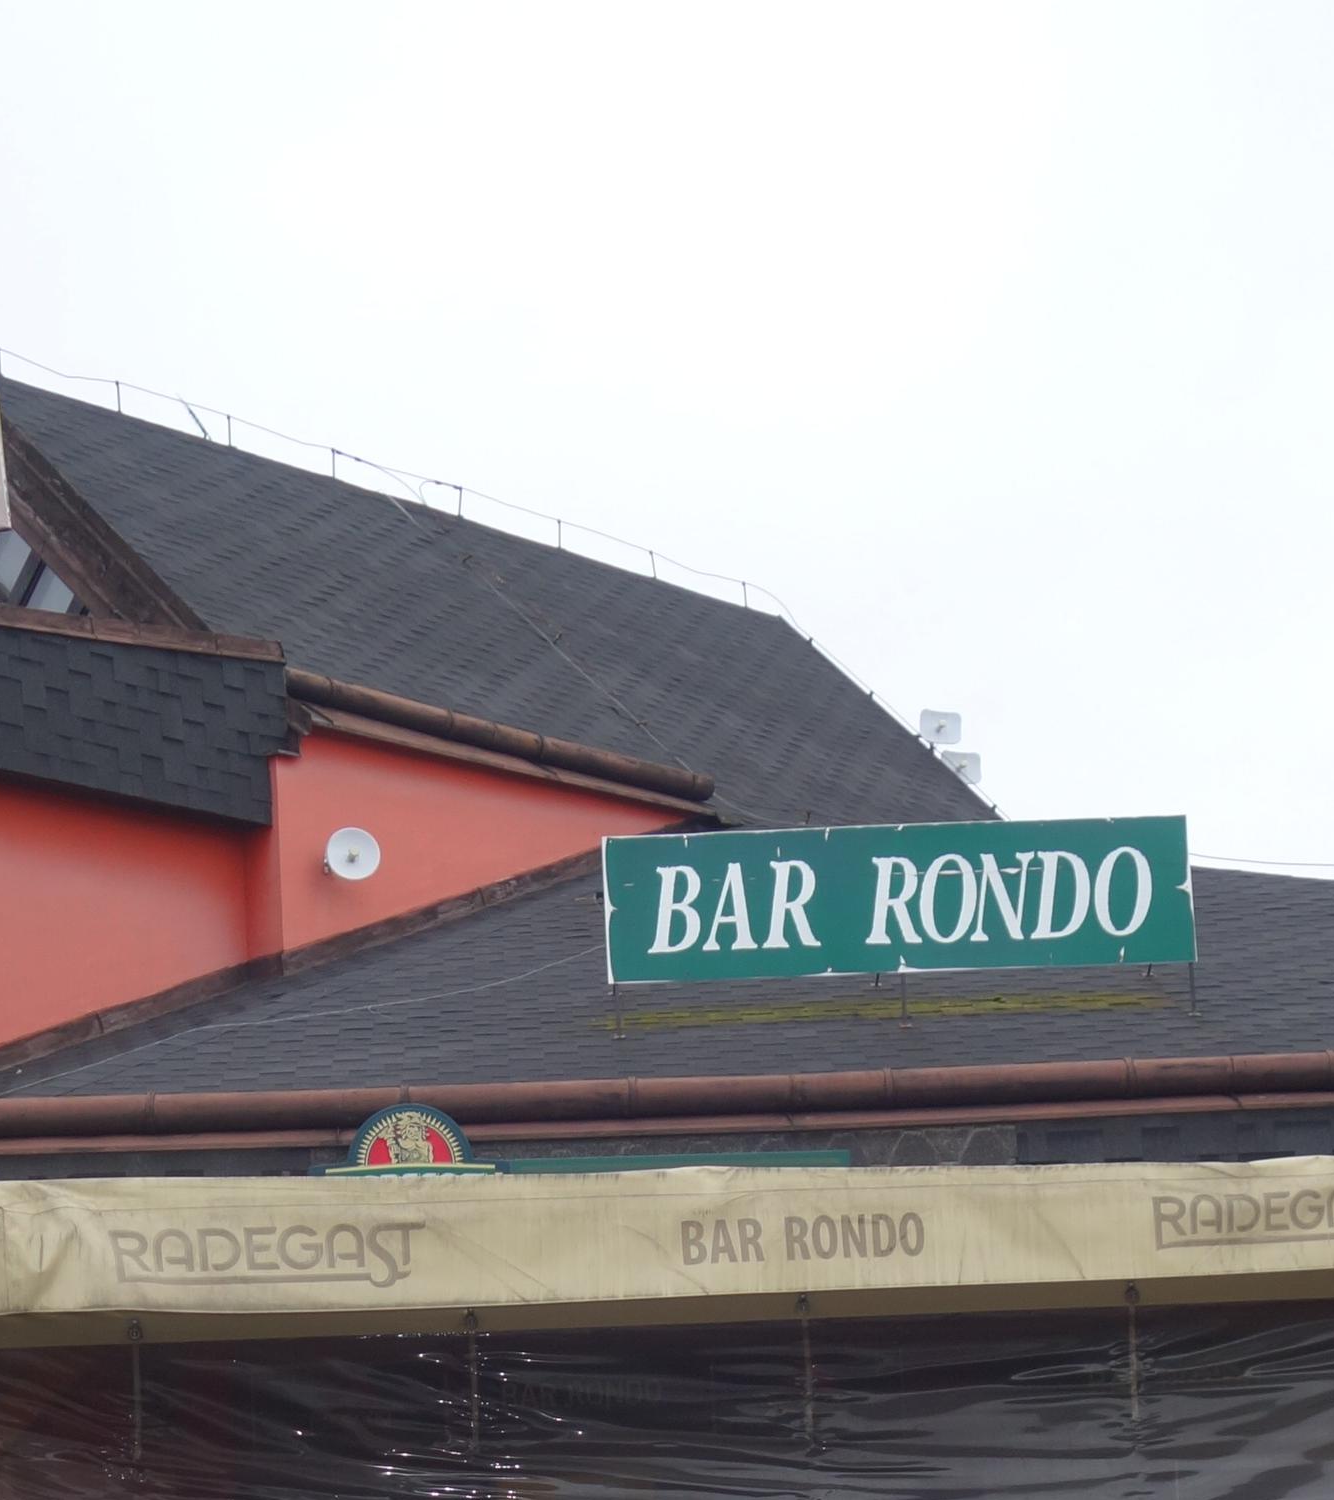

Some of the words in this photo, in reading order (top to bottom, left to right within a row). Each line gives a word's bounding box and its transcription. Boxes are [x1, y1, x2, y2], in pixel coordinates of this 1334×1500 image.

[648, 858, 822, 954] BAR
[865, 846, 1154, 944] RONDO
[110, 1220, 426, 1289] RADEGAST
[680, 1218, 765, 1266] BAR
[784, 1212, 925, 1260] RONDO
